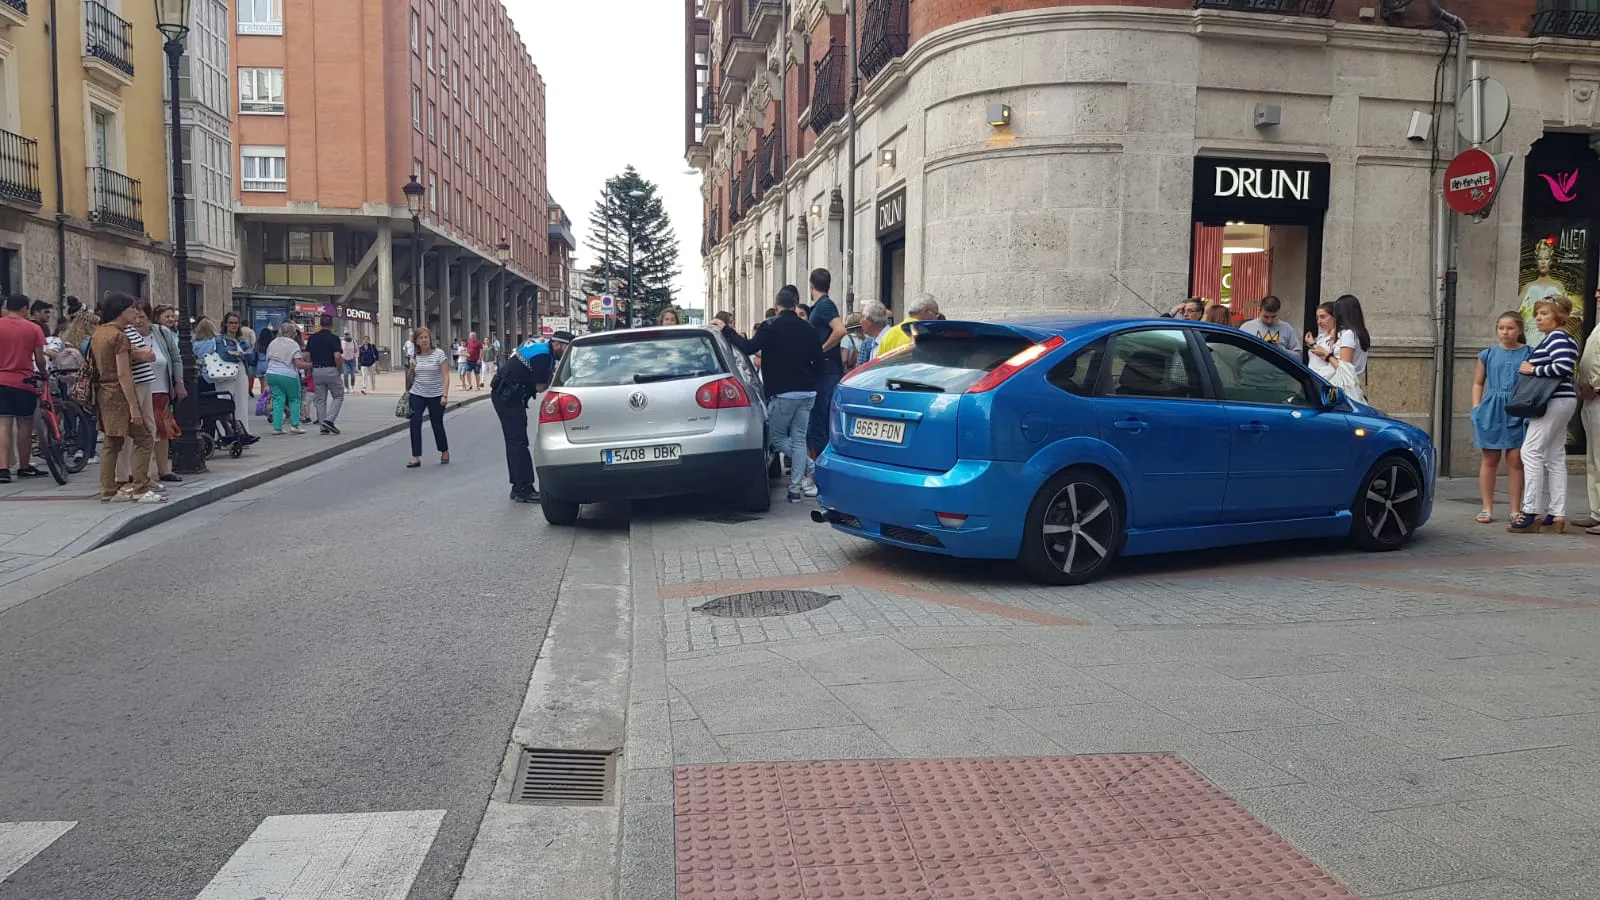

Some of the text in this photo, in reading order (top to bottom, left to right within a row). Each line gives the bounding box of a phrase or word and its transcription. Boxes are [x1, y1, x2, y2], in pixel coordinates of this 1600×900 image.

[1214, 166, 1311, 201] DRUNI
[879, 195, 902, 231] DRUNI
[346, 308, 371, 320] DENTIX
[393, 316, 405, 325] NTIX
[855, 420, 902, 441] 9663 FDN
[615, 446, 678, 462] 5408 DBK
